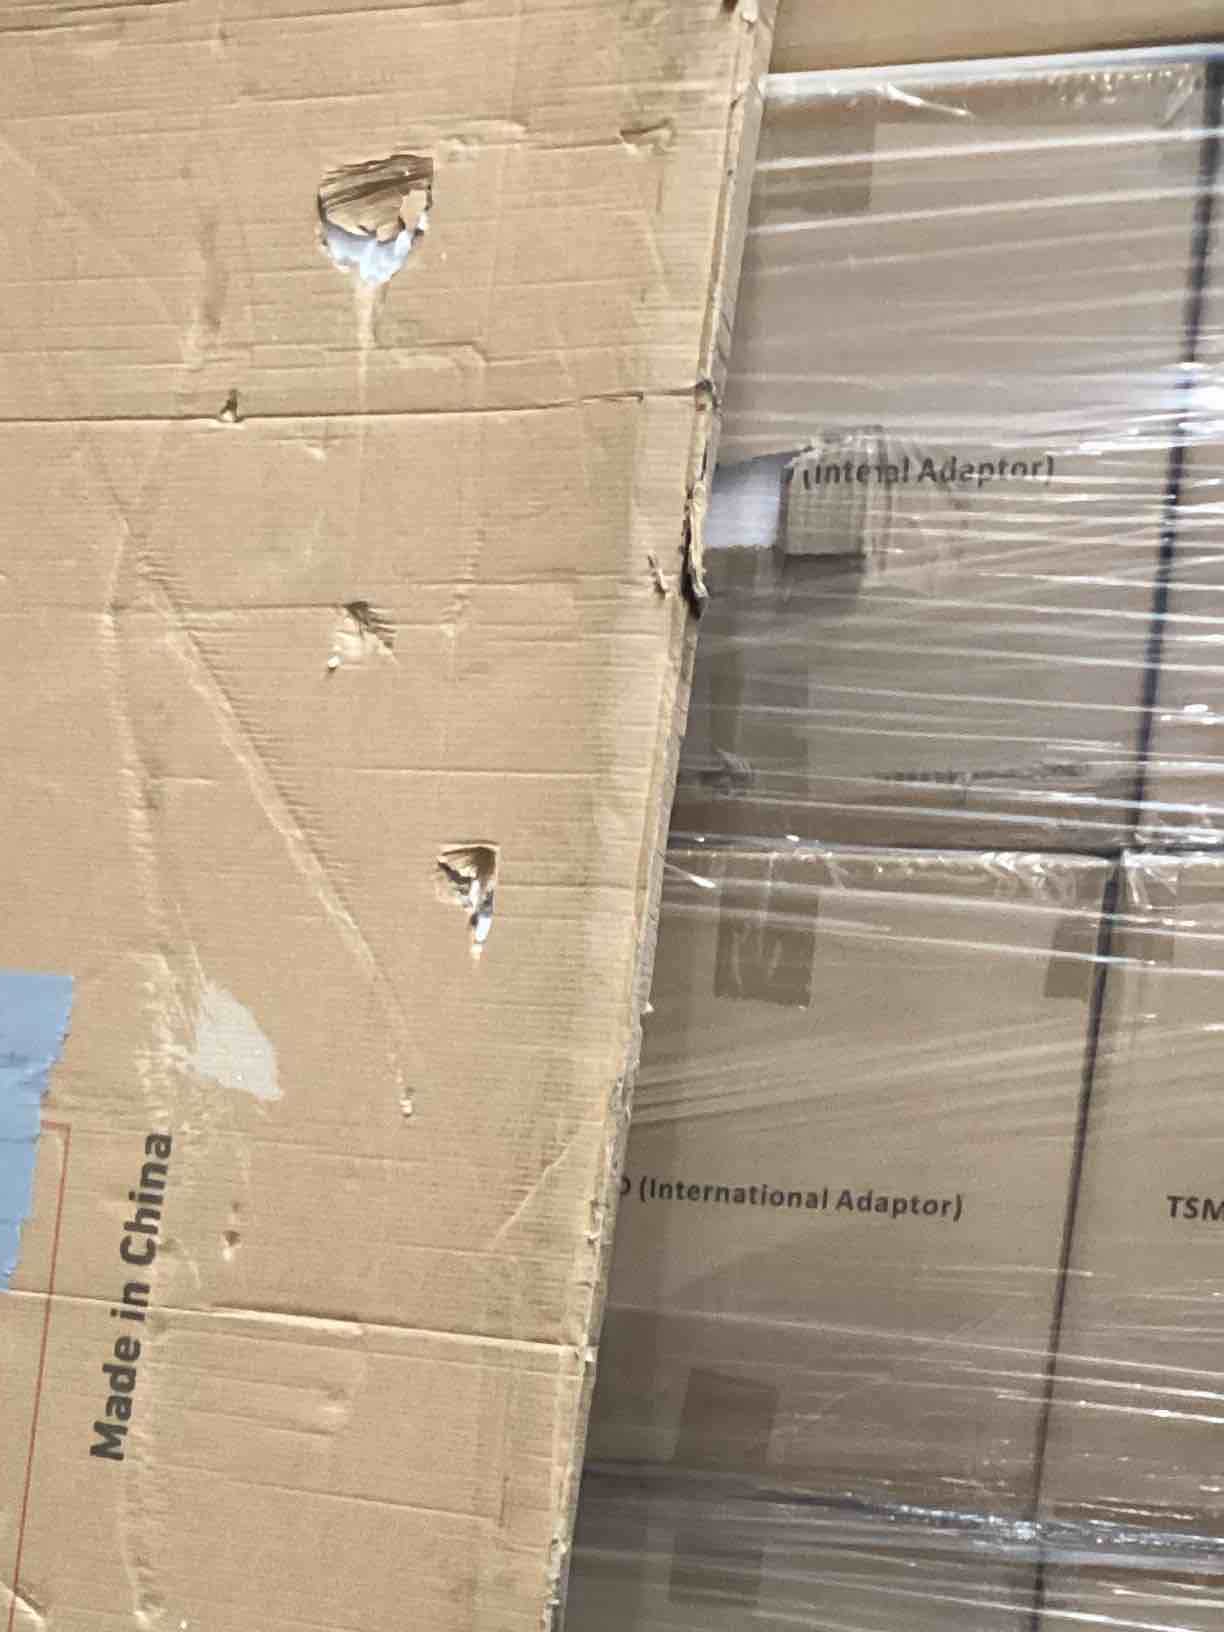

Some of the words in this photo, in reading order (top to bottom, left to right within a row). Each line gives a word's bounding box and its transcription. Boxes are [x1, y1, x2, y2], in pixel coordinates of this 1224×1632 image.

[120, 1131, 174, 1266] China
[639, 1176, 829, 1211] (International
[835, 1188, 963, 1222] Adaptor)
[110, 1280, 151, 1322] in
[89, 1335, 142, 1462] Made
